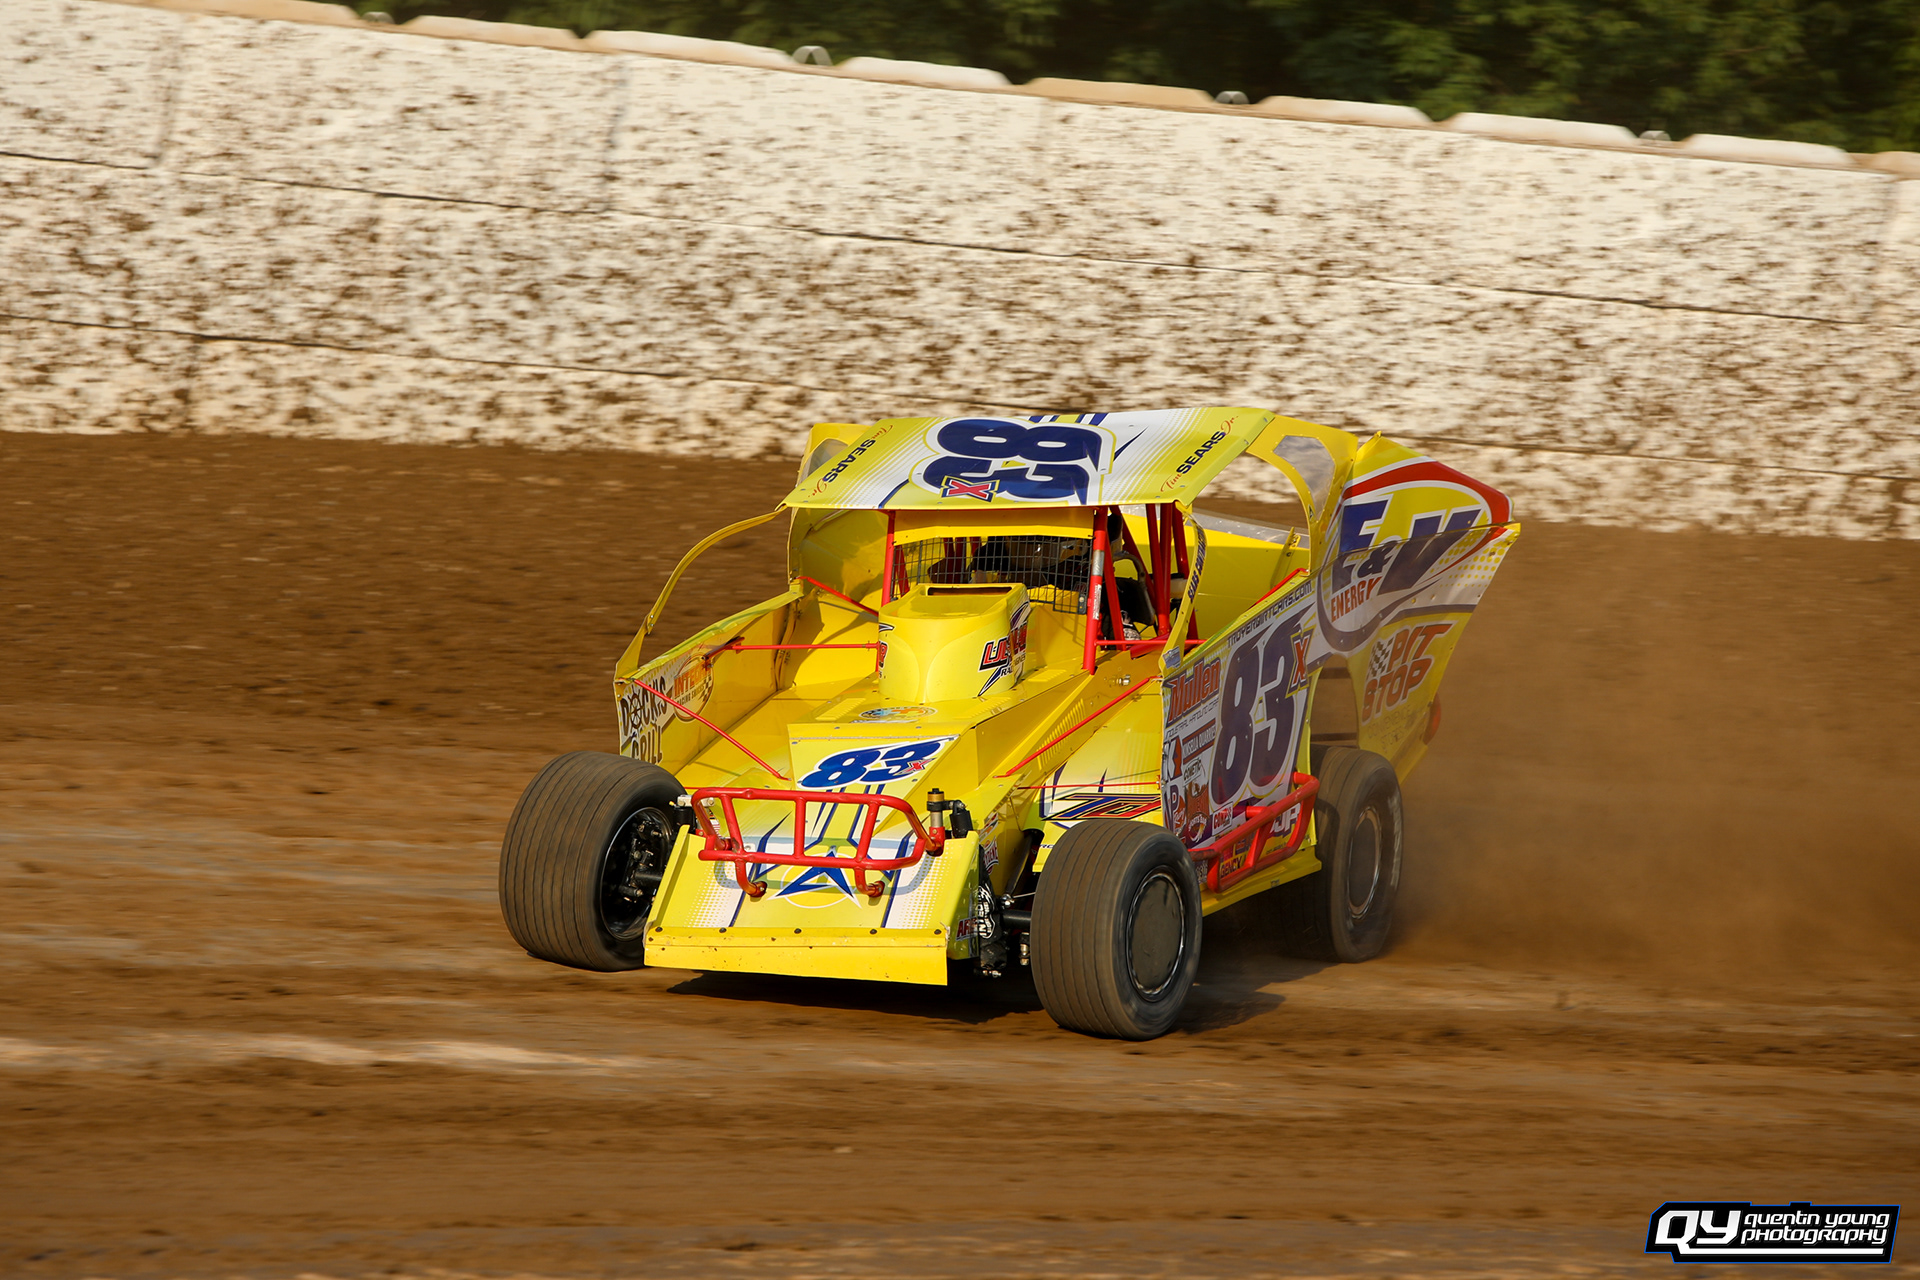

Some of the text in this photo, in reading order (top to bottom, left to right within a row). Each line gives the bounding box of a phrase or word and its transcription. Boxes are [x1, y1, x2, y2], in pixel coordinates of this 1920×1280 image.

[825, 438, 878, 485] SEARS
[1176, 429, 1227, 475] SEARS
[1330, 576, 1383, 624] ENERGY
[1387, 620, 1454, 673] PIT
[1167, 658, 1221, 724] Mullen
[1361, 657, 1435, 725] STOP
